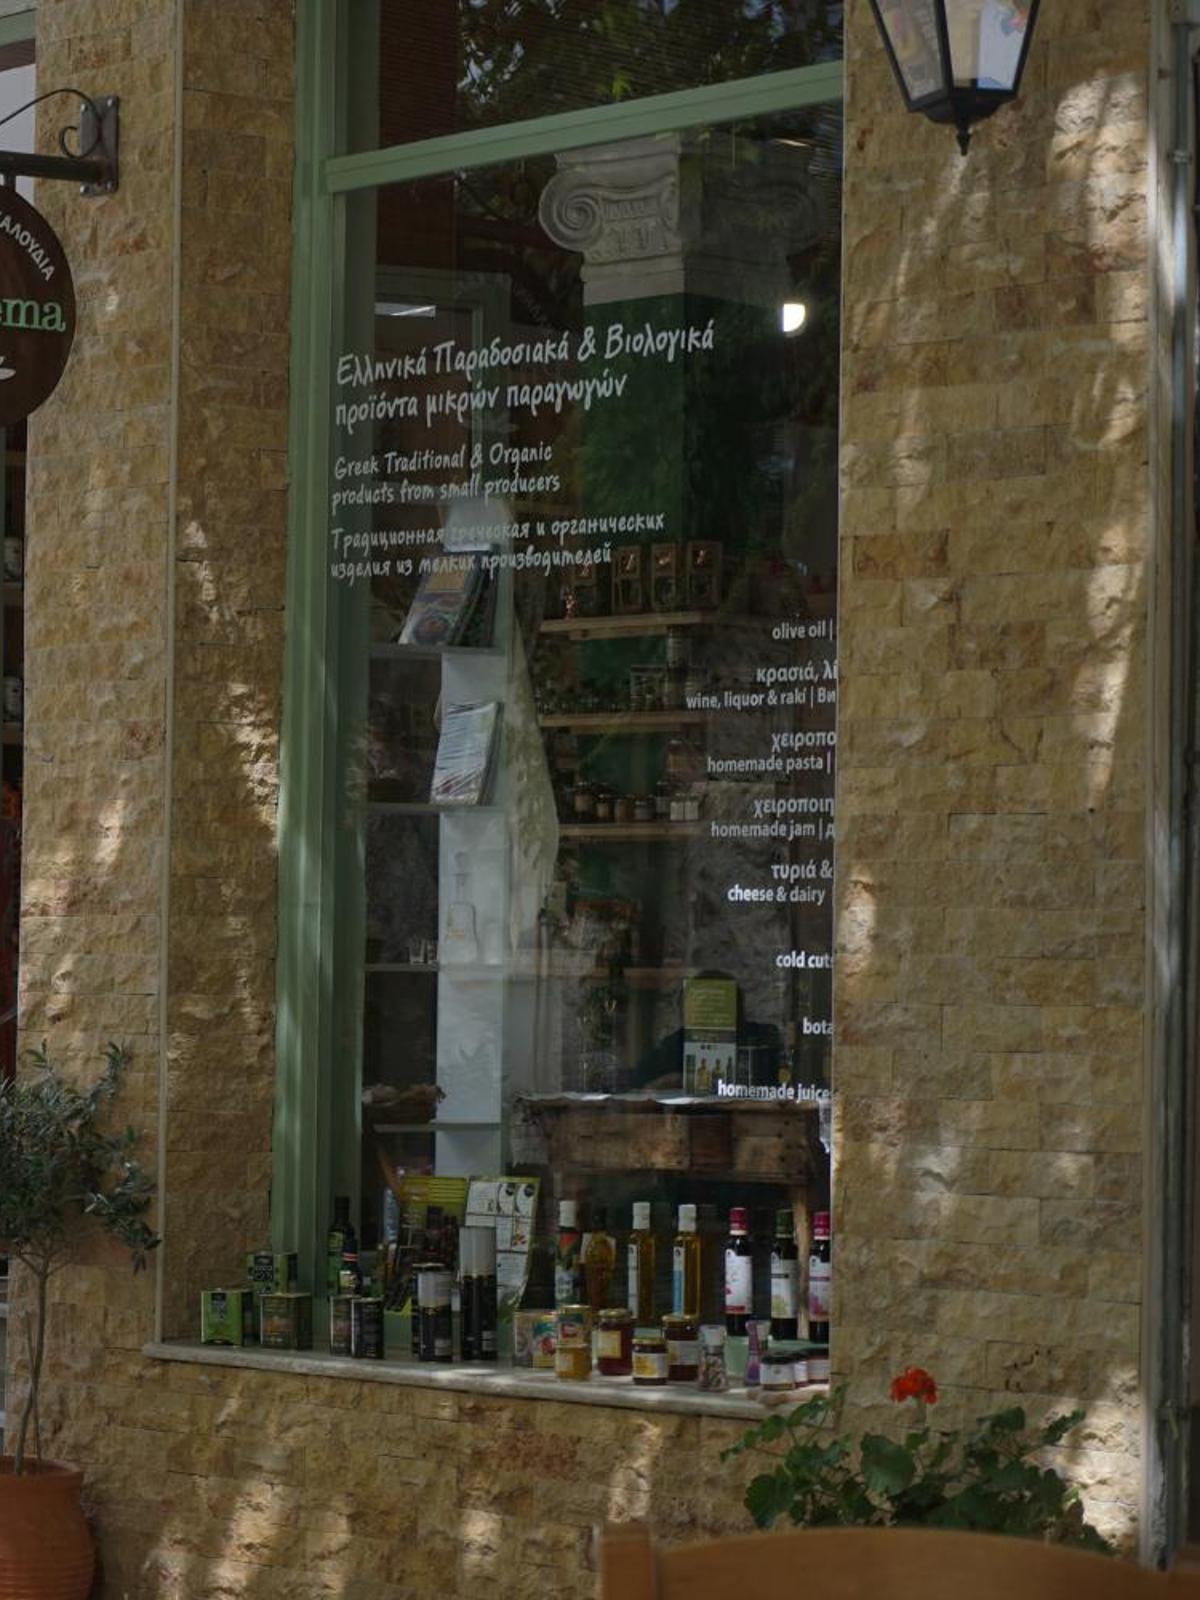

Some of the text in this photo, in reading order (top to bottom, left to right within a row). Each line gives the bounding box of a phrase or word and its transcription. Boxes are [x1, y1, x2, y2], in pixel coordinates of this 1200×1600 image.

[336, 319, 715, 388] Ελληνικά Παραδοσιακά & Βιολογικά
[335, 391, 419, 436] προϊόντα
[426, 380, 500, 429] μικρών
[334, 440, 554, 481] Greek Traditional & Organic
[332, 471, 561, 517] products from small producers
[771, 621, 805, 640] olive
[807, 620, 826, 637] oil
[724, 690, 765, 710] liquor
[767, 689, 778, 706] &
[707, 755, 784, 774] homemade
[786, 754, 823, 775] pasta
[711, 819, 787, 838] homemade
[788, 818, 816, 841] jam
[770, 858, 818, 884] τυριά
[727, 884, 826, 907] cheese & dairy
[775, 949, 834, 969] cold cut
[717, 1079, 795, 1099] homemade
